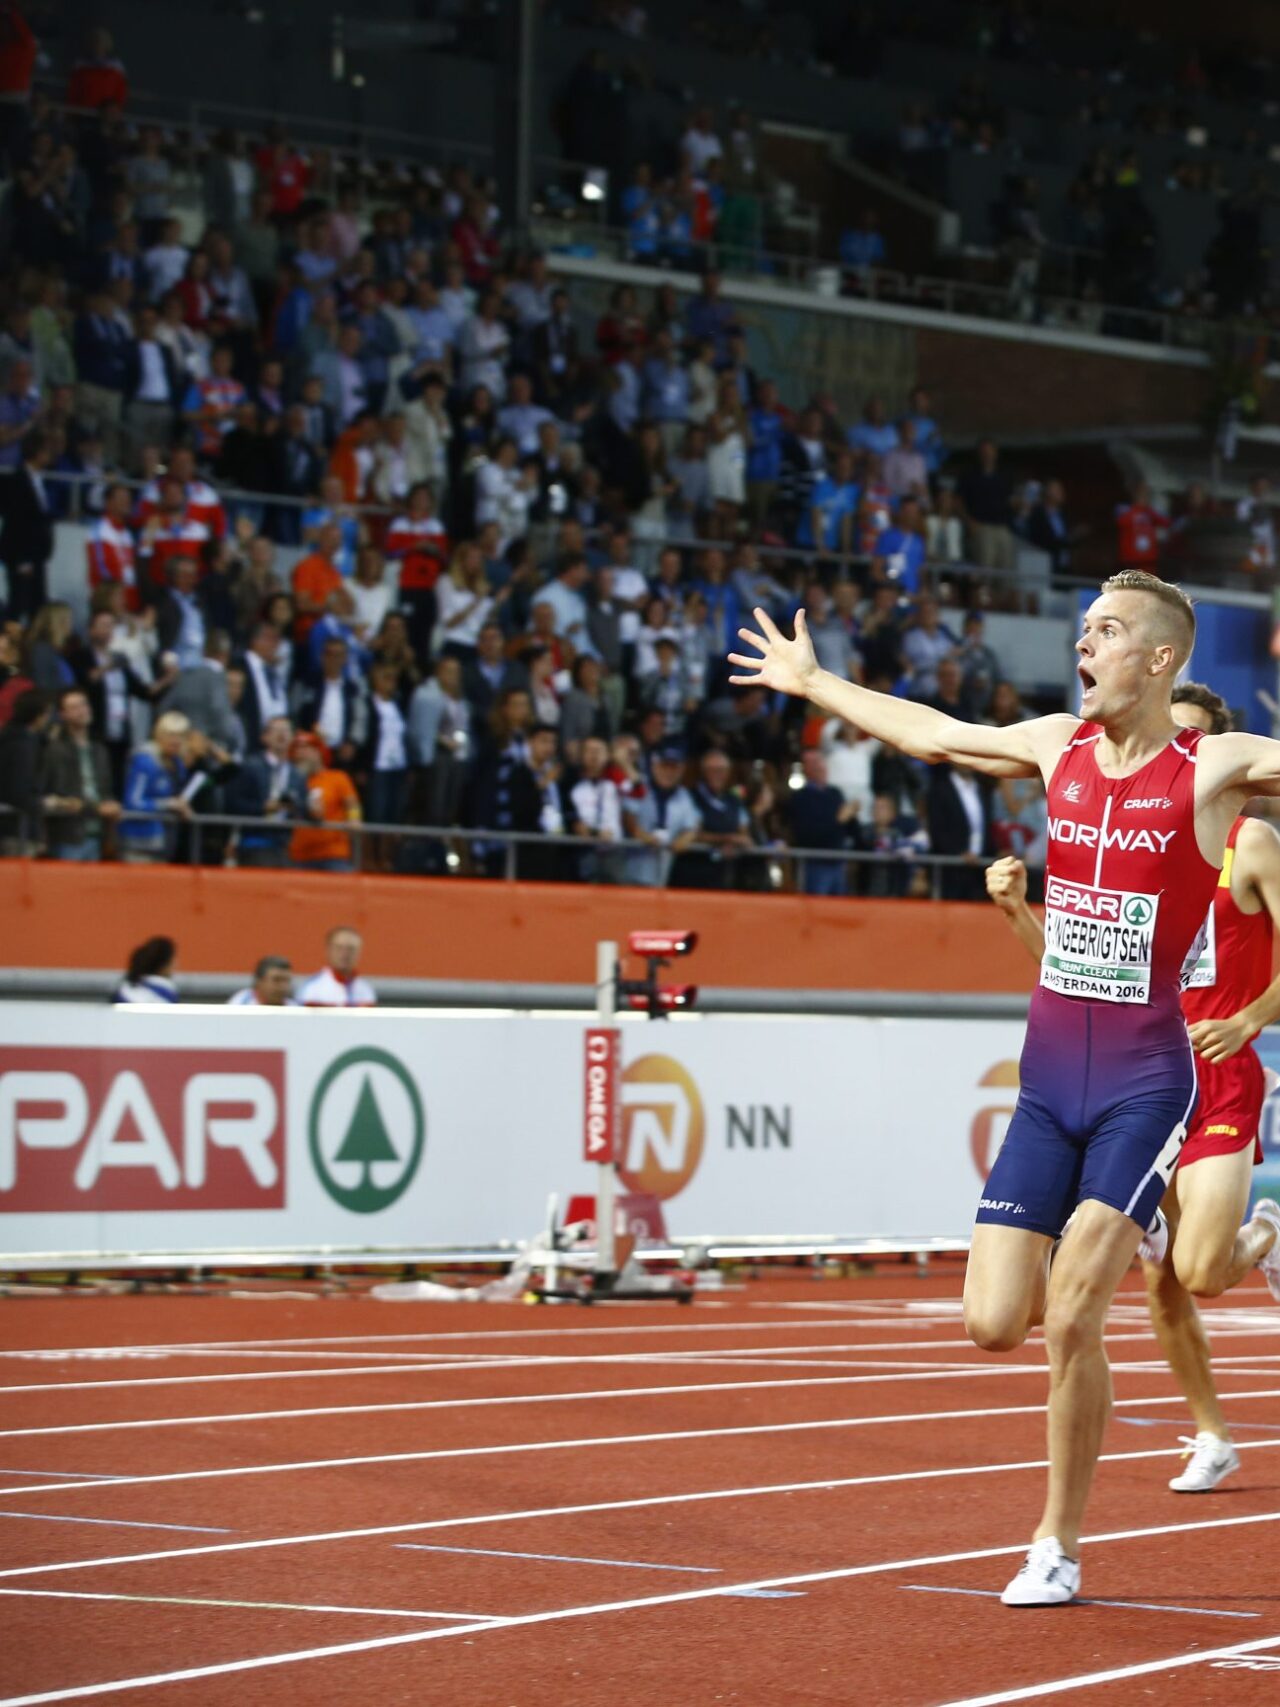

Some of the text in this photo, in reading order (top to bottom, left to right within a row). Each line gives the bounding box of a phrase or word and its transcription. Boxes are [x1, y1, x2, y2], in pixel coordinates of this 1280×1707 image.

[1123, 798, 1163, 810] CRAFT
[1047, 816, 1177, 853] NORWAY
[1048, 885, 1119, 919] SPAR
[1044, 970, 1146, 999] AMSTERDAM 2016
[1083, 964, 1118, 979] CLEAN
[588, 1064, 607, 1152] OMEGA
[725, 1104, 792, 1149] NN
[980, 1199, 1014, 1212] CRAFT
